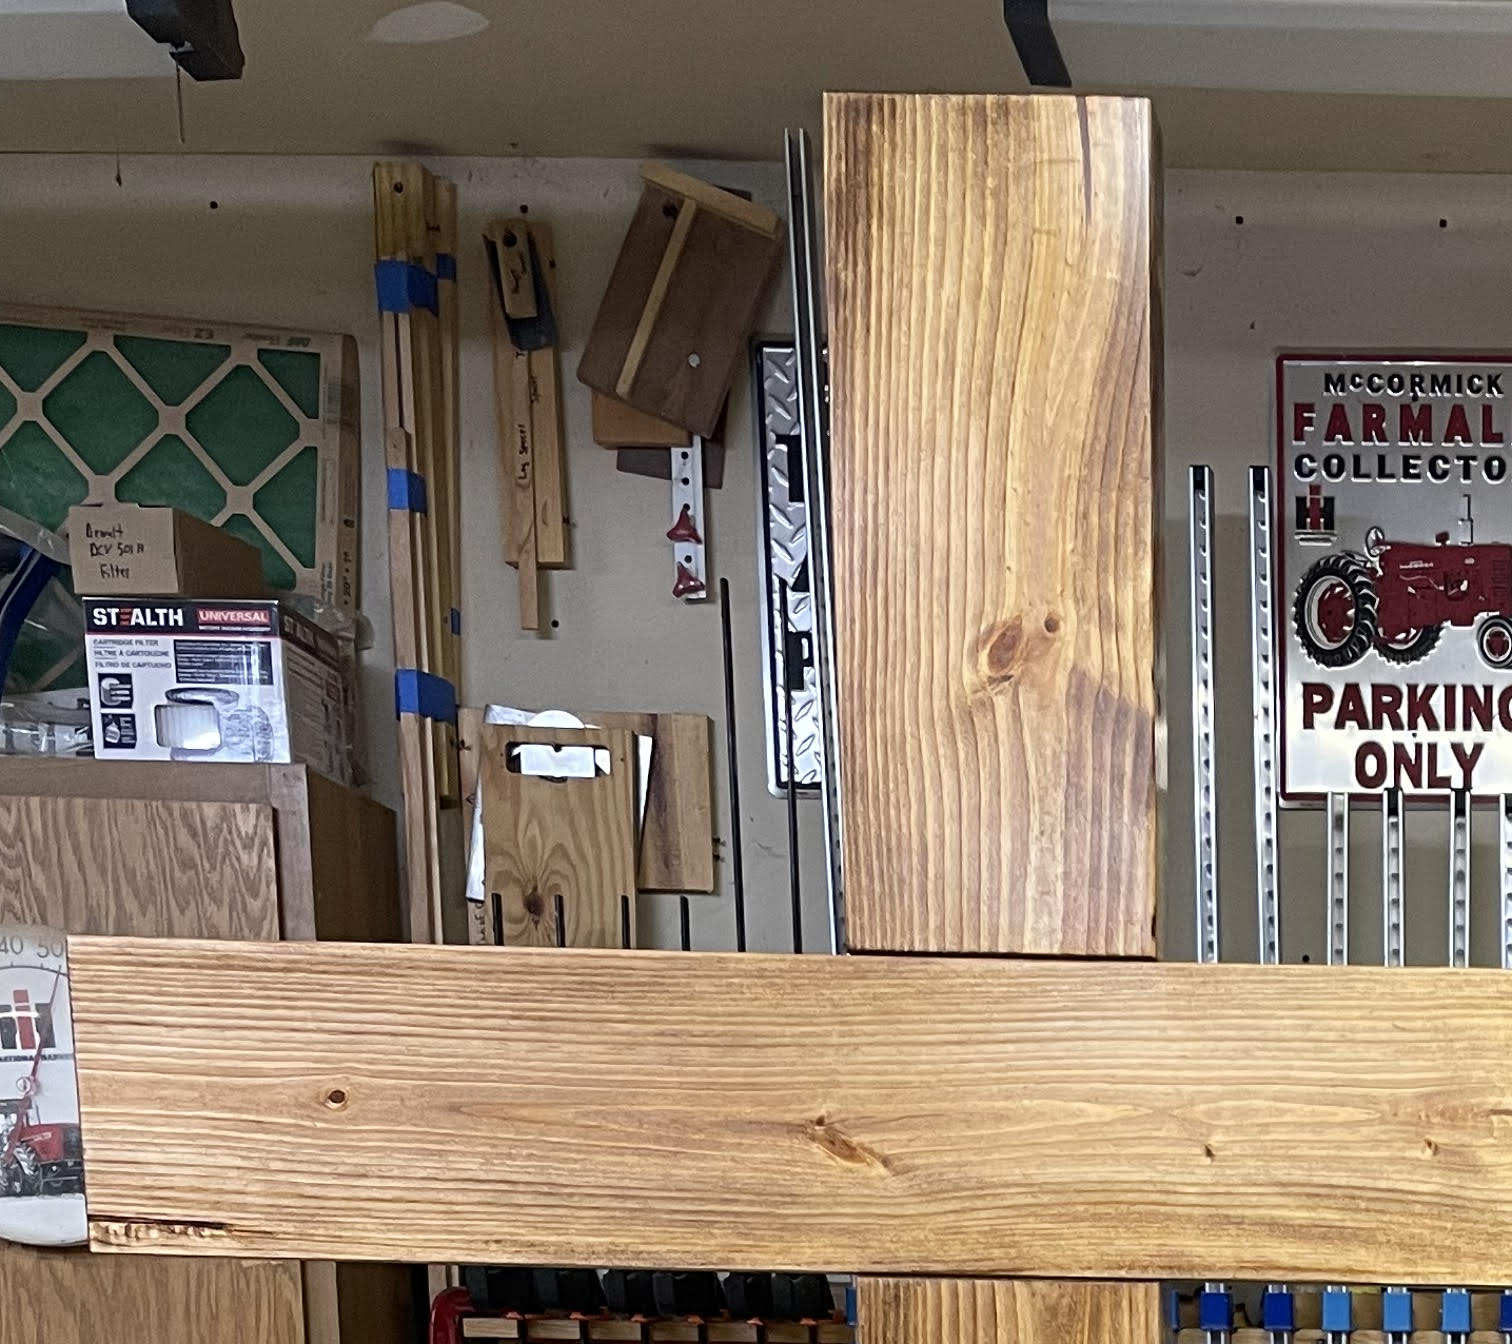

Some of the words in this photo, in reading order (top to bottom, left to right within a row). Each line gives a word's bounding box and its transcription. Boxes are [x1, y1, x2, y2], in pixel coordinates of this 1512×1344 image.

[93, 607, 184, 626] STEALTH
[199, 610, 269, 622] UNIVERSAL
[1355, 741, 1484, 790] ONLY
[37, 937, 65, 959] 50
